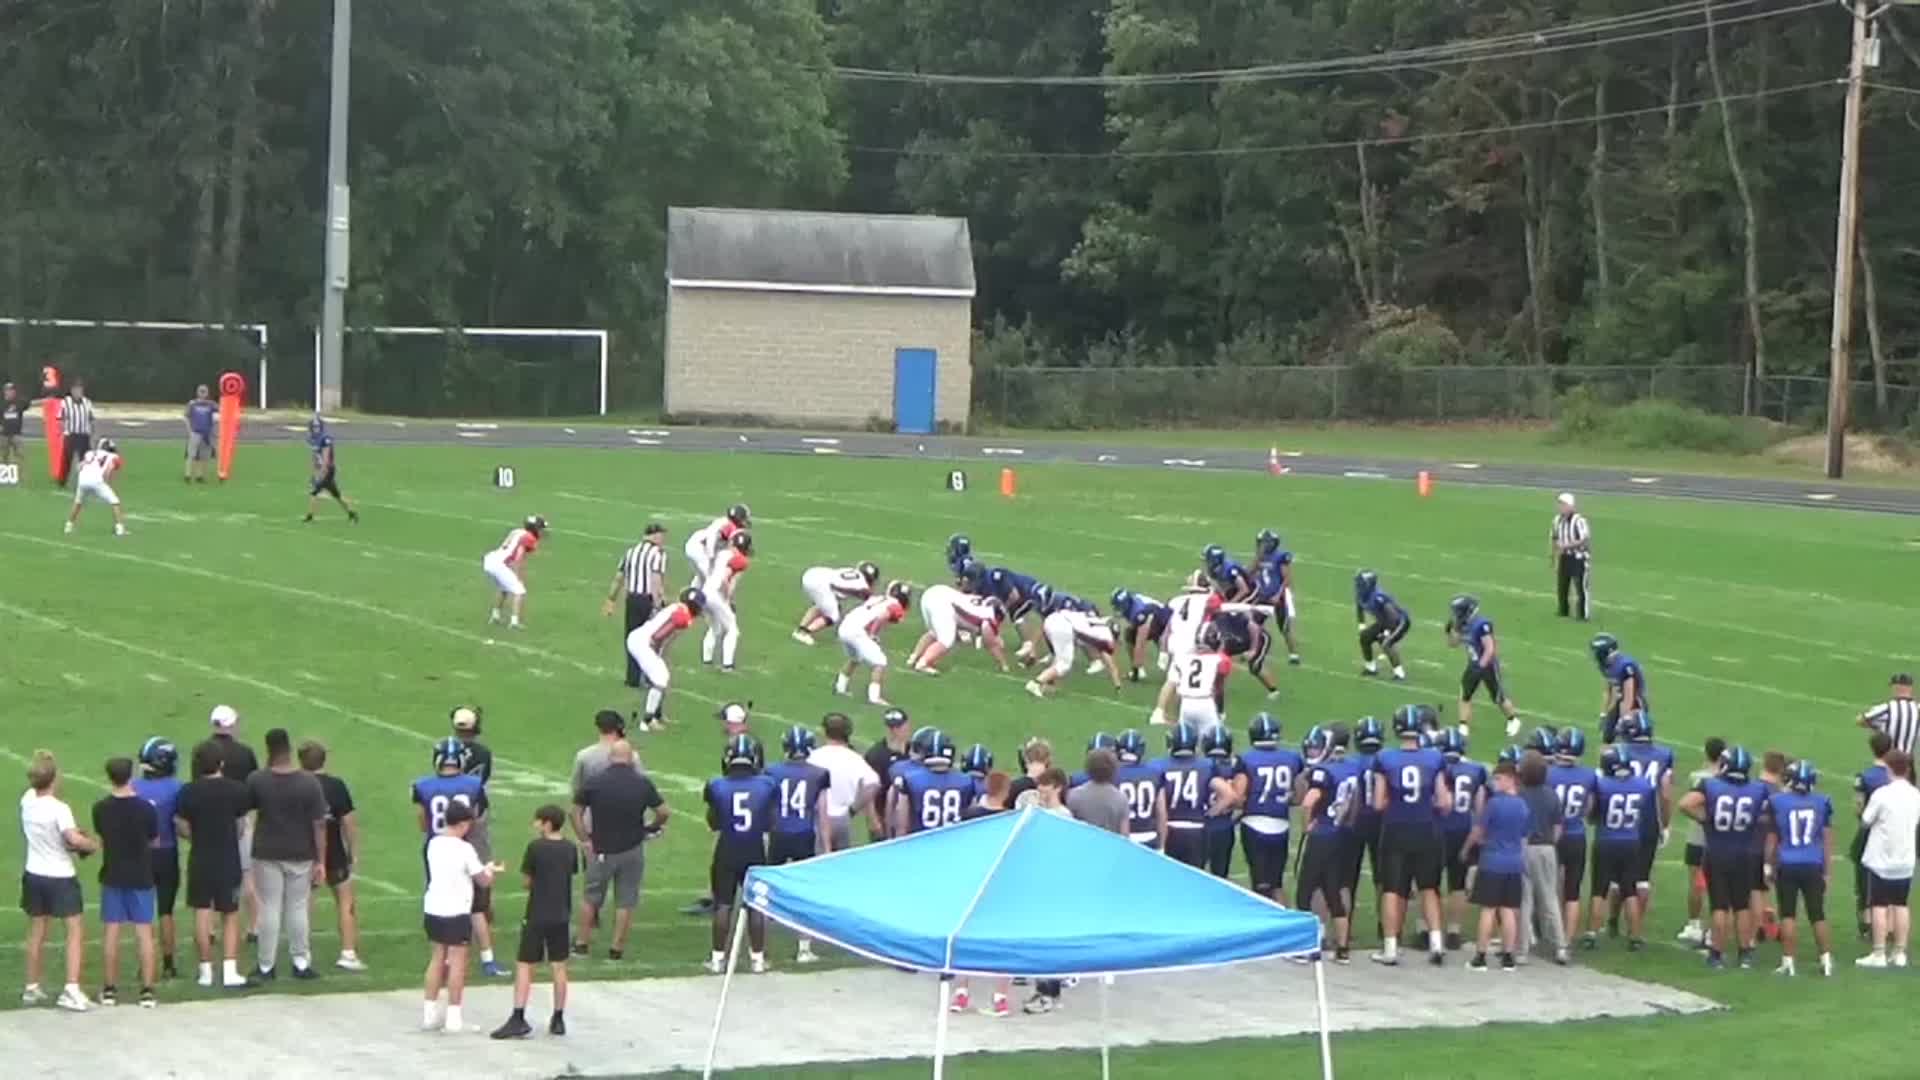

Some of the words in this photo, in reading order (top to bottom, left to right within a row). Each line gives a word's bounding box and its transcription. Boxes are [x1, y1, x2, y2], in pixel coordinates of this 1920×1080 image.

[0, 464, 18, 484] 20
[498, 467, 514, 488] 10
[1188, 659, 1202, 689] 2
[779, 778, 806, 819] 14
[1165, 770, 1197, 809] 74
[1258, 765, 1289, 804] 79
[1402, 765, 1420, 803] 9
[733, 791, 752, 833] 5
[922, 789, 961, 828] 68
[1606, 793, 1642, 829] 65
[1715, 795, 1754, 832] 66
[1789, 809, 1815, 846] 17
